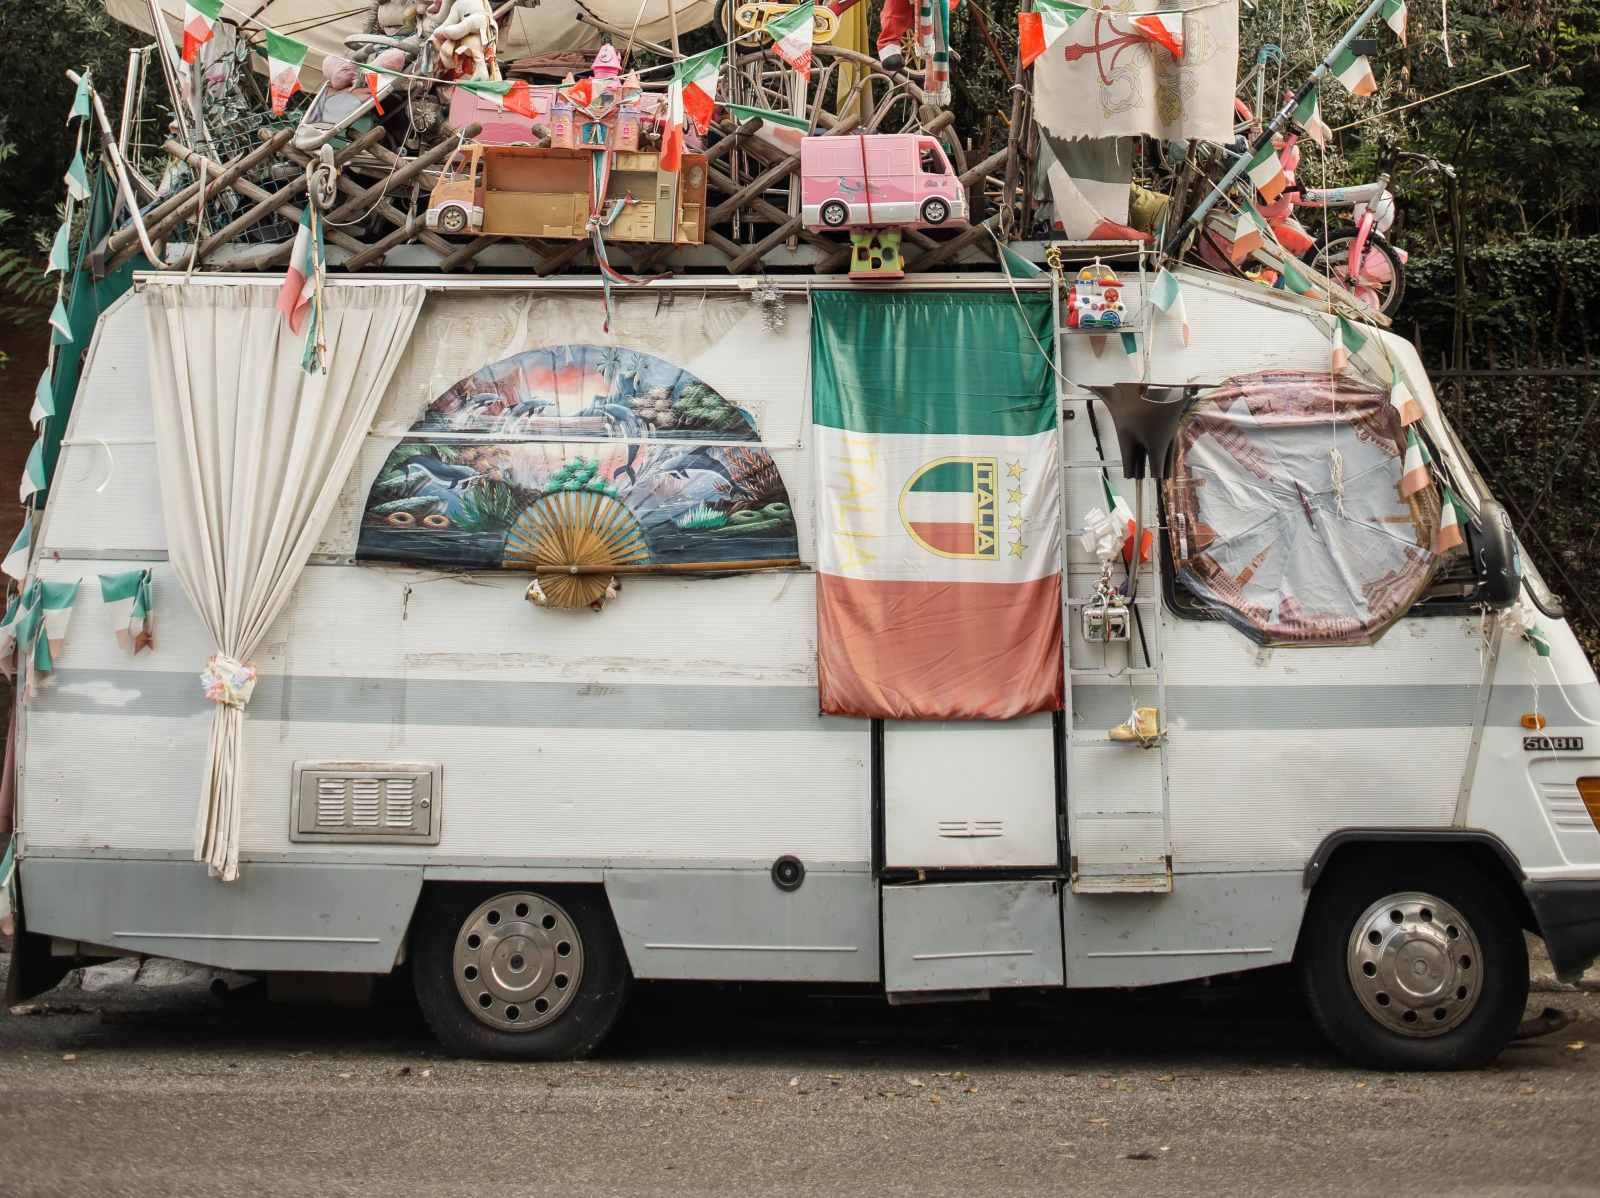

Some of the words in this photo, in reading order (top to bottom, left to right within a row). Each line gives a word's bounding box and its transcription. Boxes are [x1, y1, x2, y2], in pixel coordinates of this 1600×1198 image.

[839, 437, 876, 570] ITALIA
[977, 464, 995, 554] ITALIA
[1525, 738, 1582, 749] 508D
